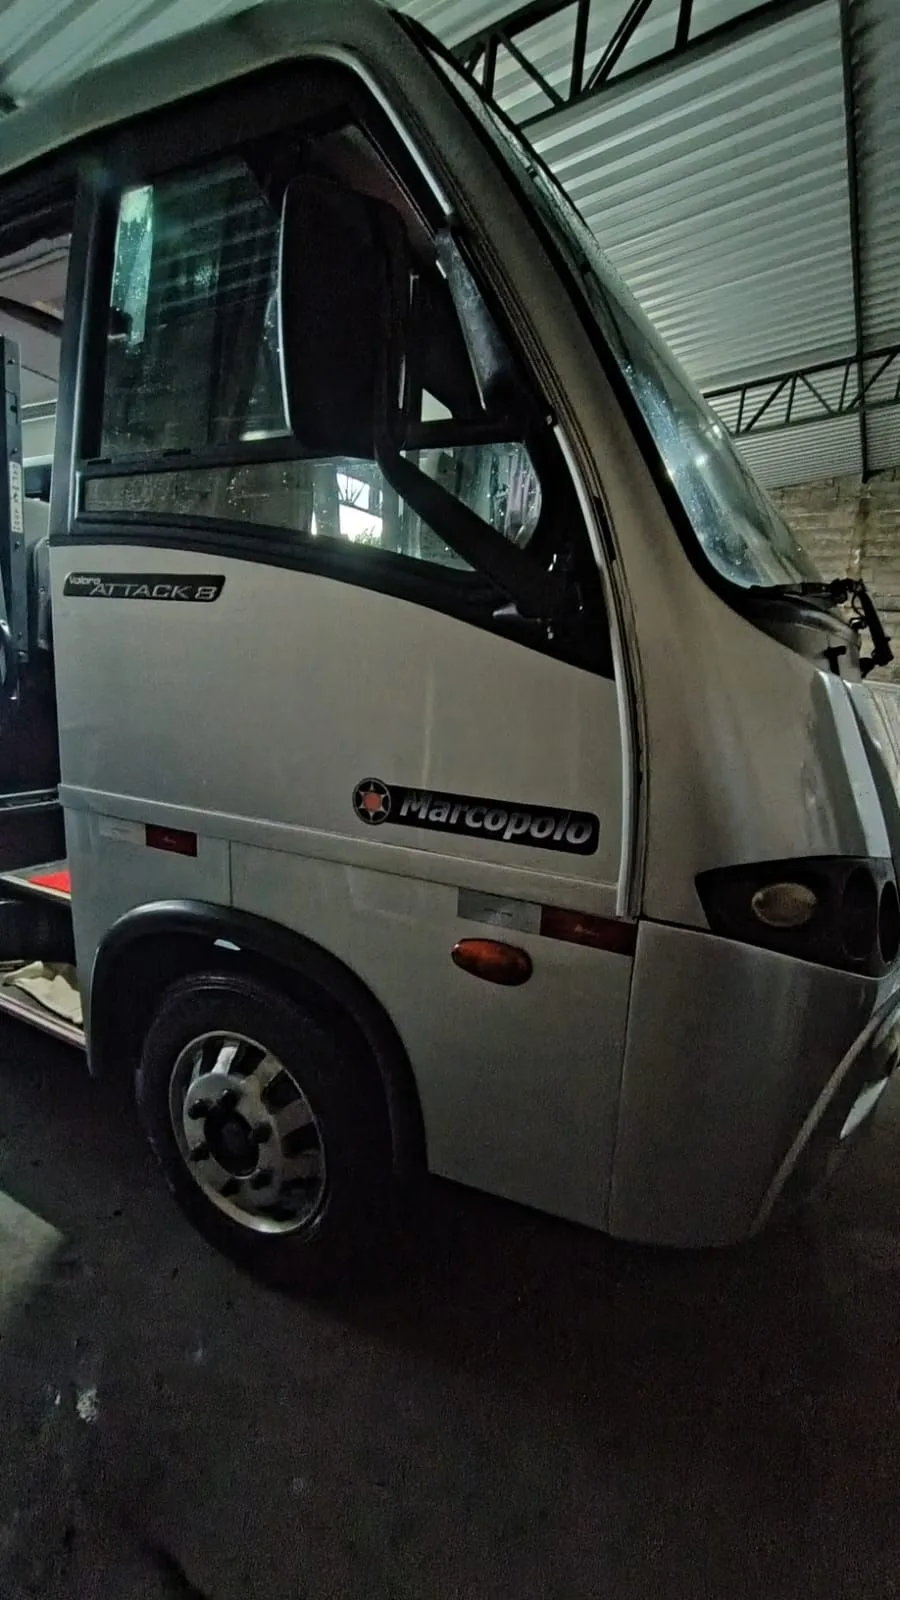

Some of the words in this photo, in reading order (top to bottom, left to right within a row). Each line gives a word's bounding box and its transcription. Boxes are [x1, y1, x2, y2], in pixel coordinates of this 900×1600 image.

[89, 583, 193, 599] ATTACK
[194, 585, 217, 600] 8
[400, 792, 593, 844] Marcopolo
